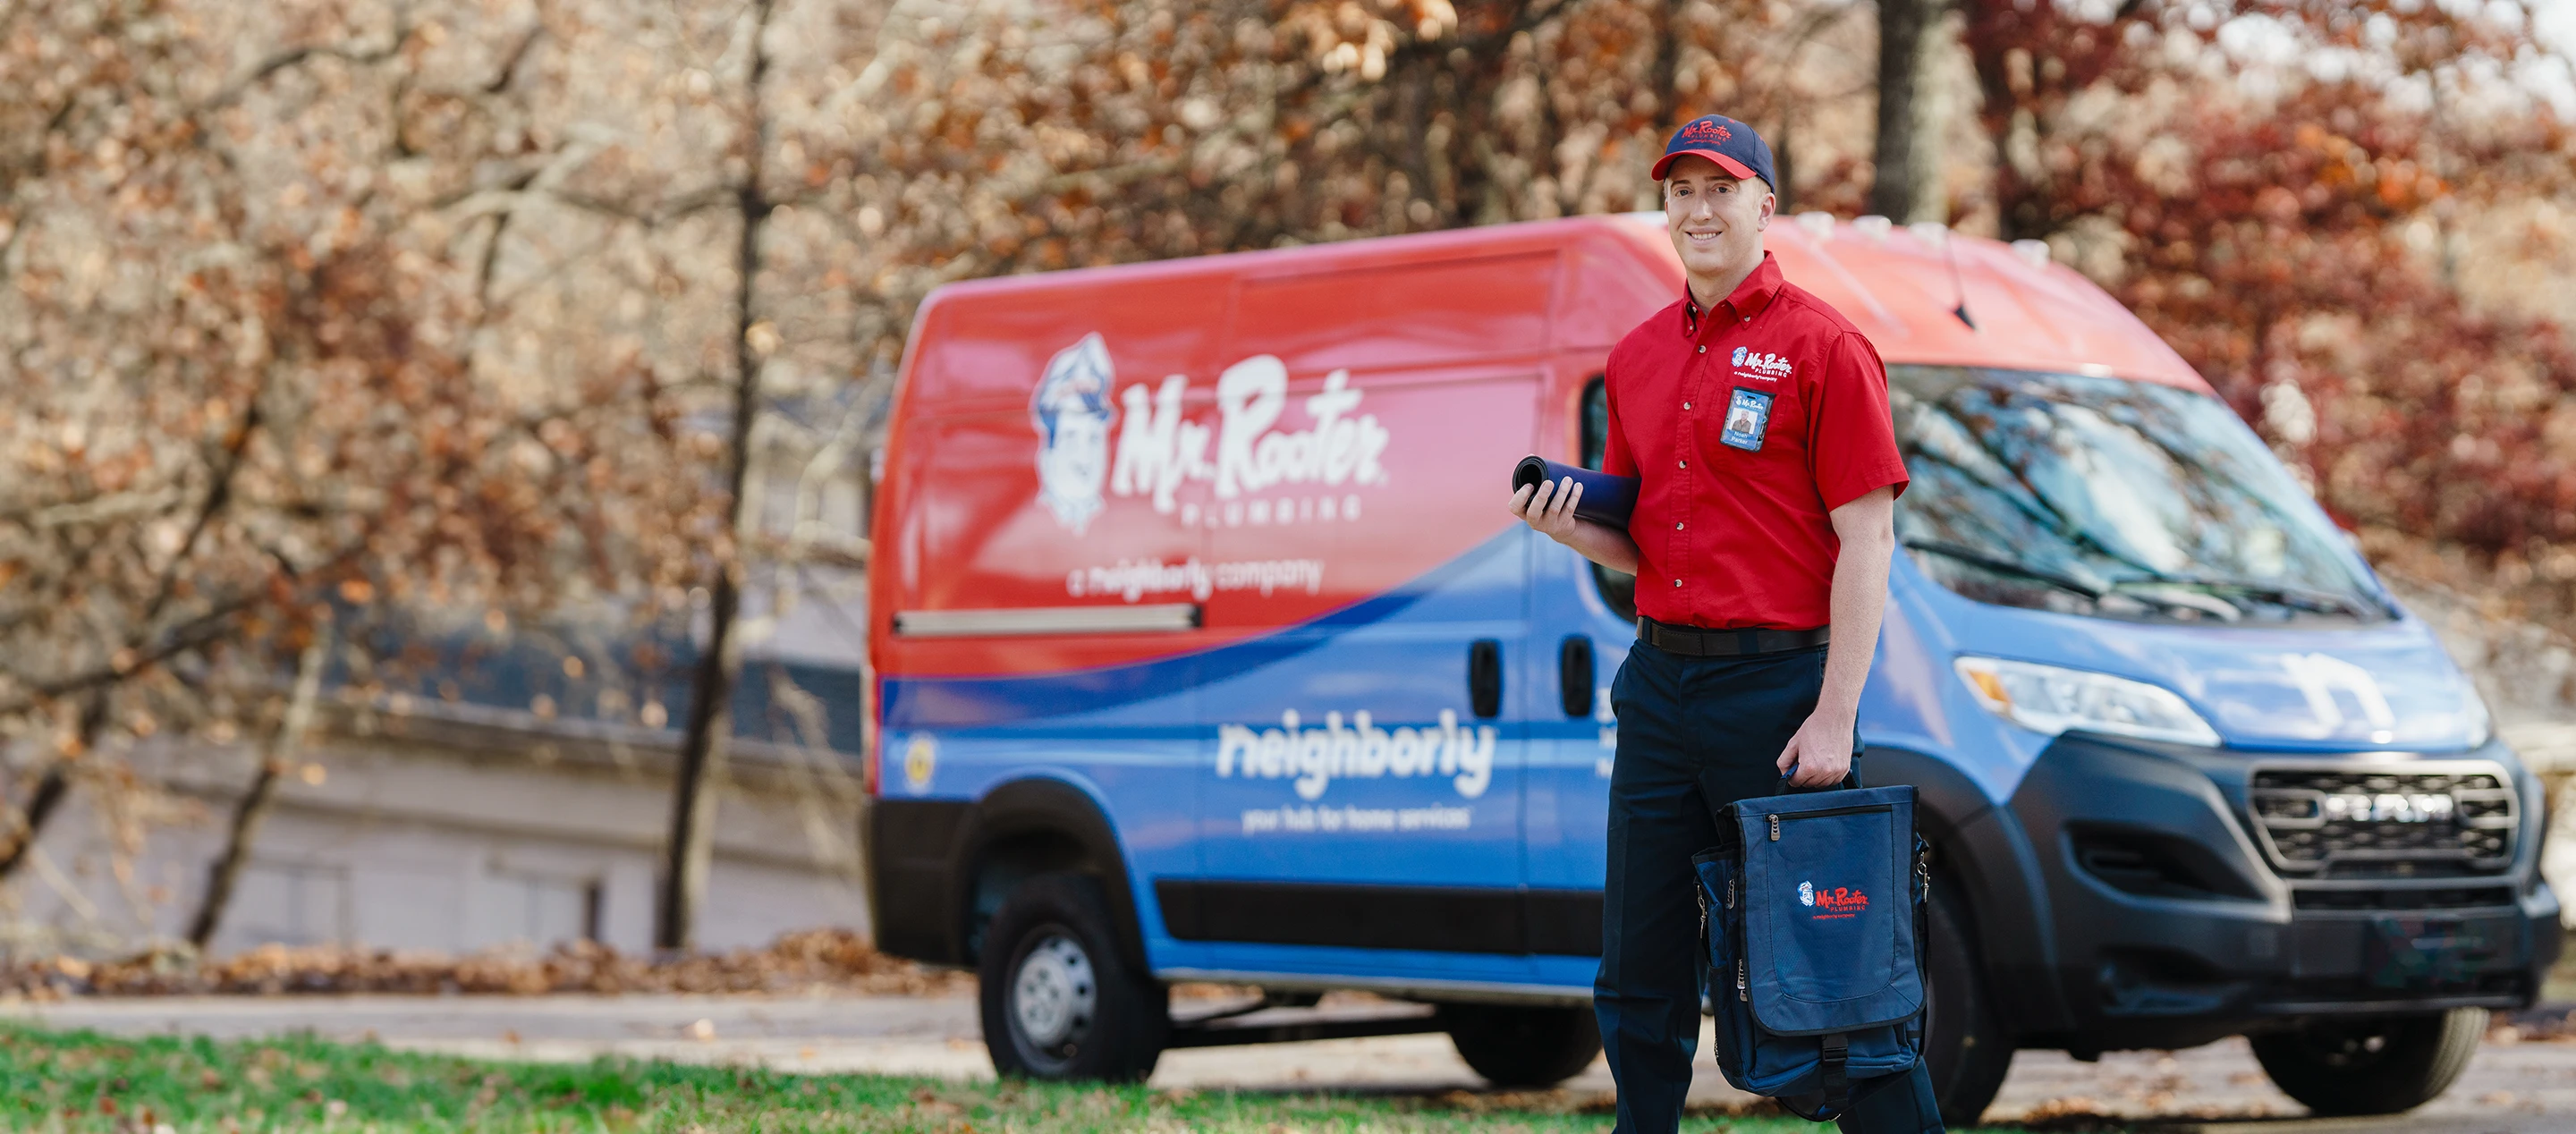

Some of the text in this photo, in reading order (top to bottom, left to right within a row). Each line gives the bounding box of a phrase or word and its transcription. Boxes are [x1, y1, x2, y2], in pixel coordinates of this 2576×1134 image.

[1682, 120, 1732, 139] Mr. Rooter
[1744, 352, 1792, 373] Mr. Rooter
[1755, 368, 1787, 378] PLUMBING
[1112, 352, 1389, 512] Mr. Rooter
[1731, 436, 1748, 444] Parker
[1181, 494, 1361, 528] PLUMBING
[1086, 557, 1214, 603] neighborly
[1215, 558, 1325, 597] company
[1216, 707, 1496, 800] neighborly
[1241, 804, 1470, 834] your hub for home services
[1816, 886, 1868, 909] Mr. Rooter
